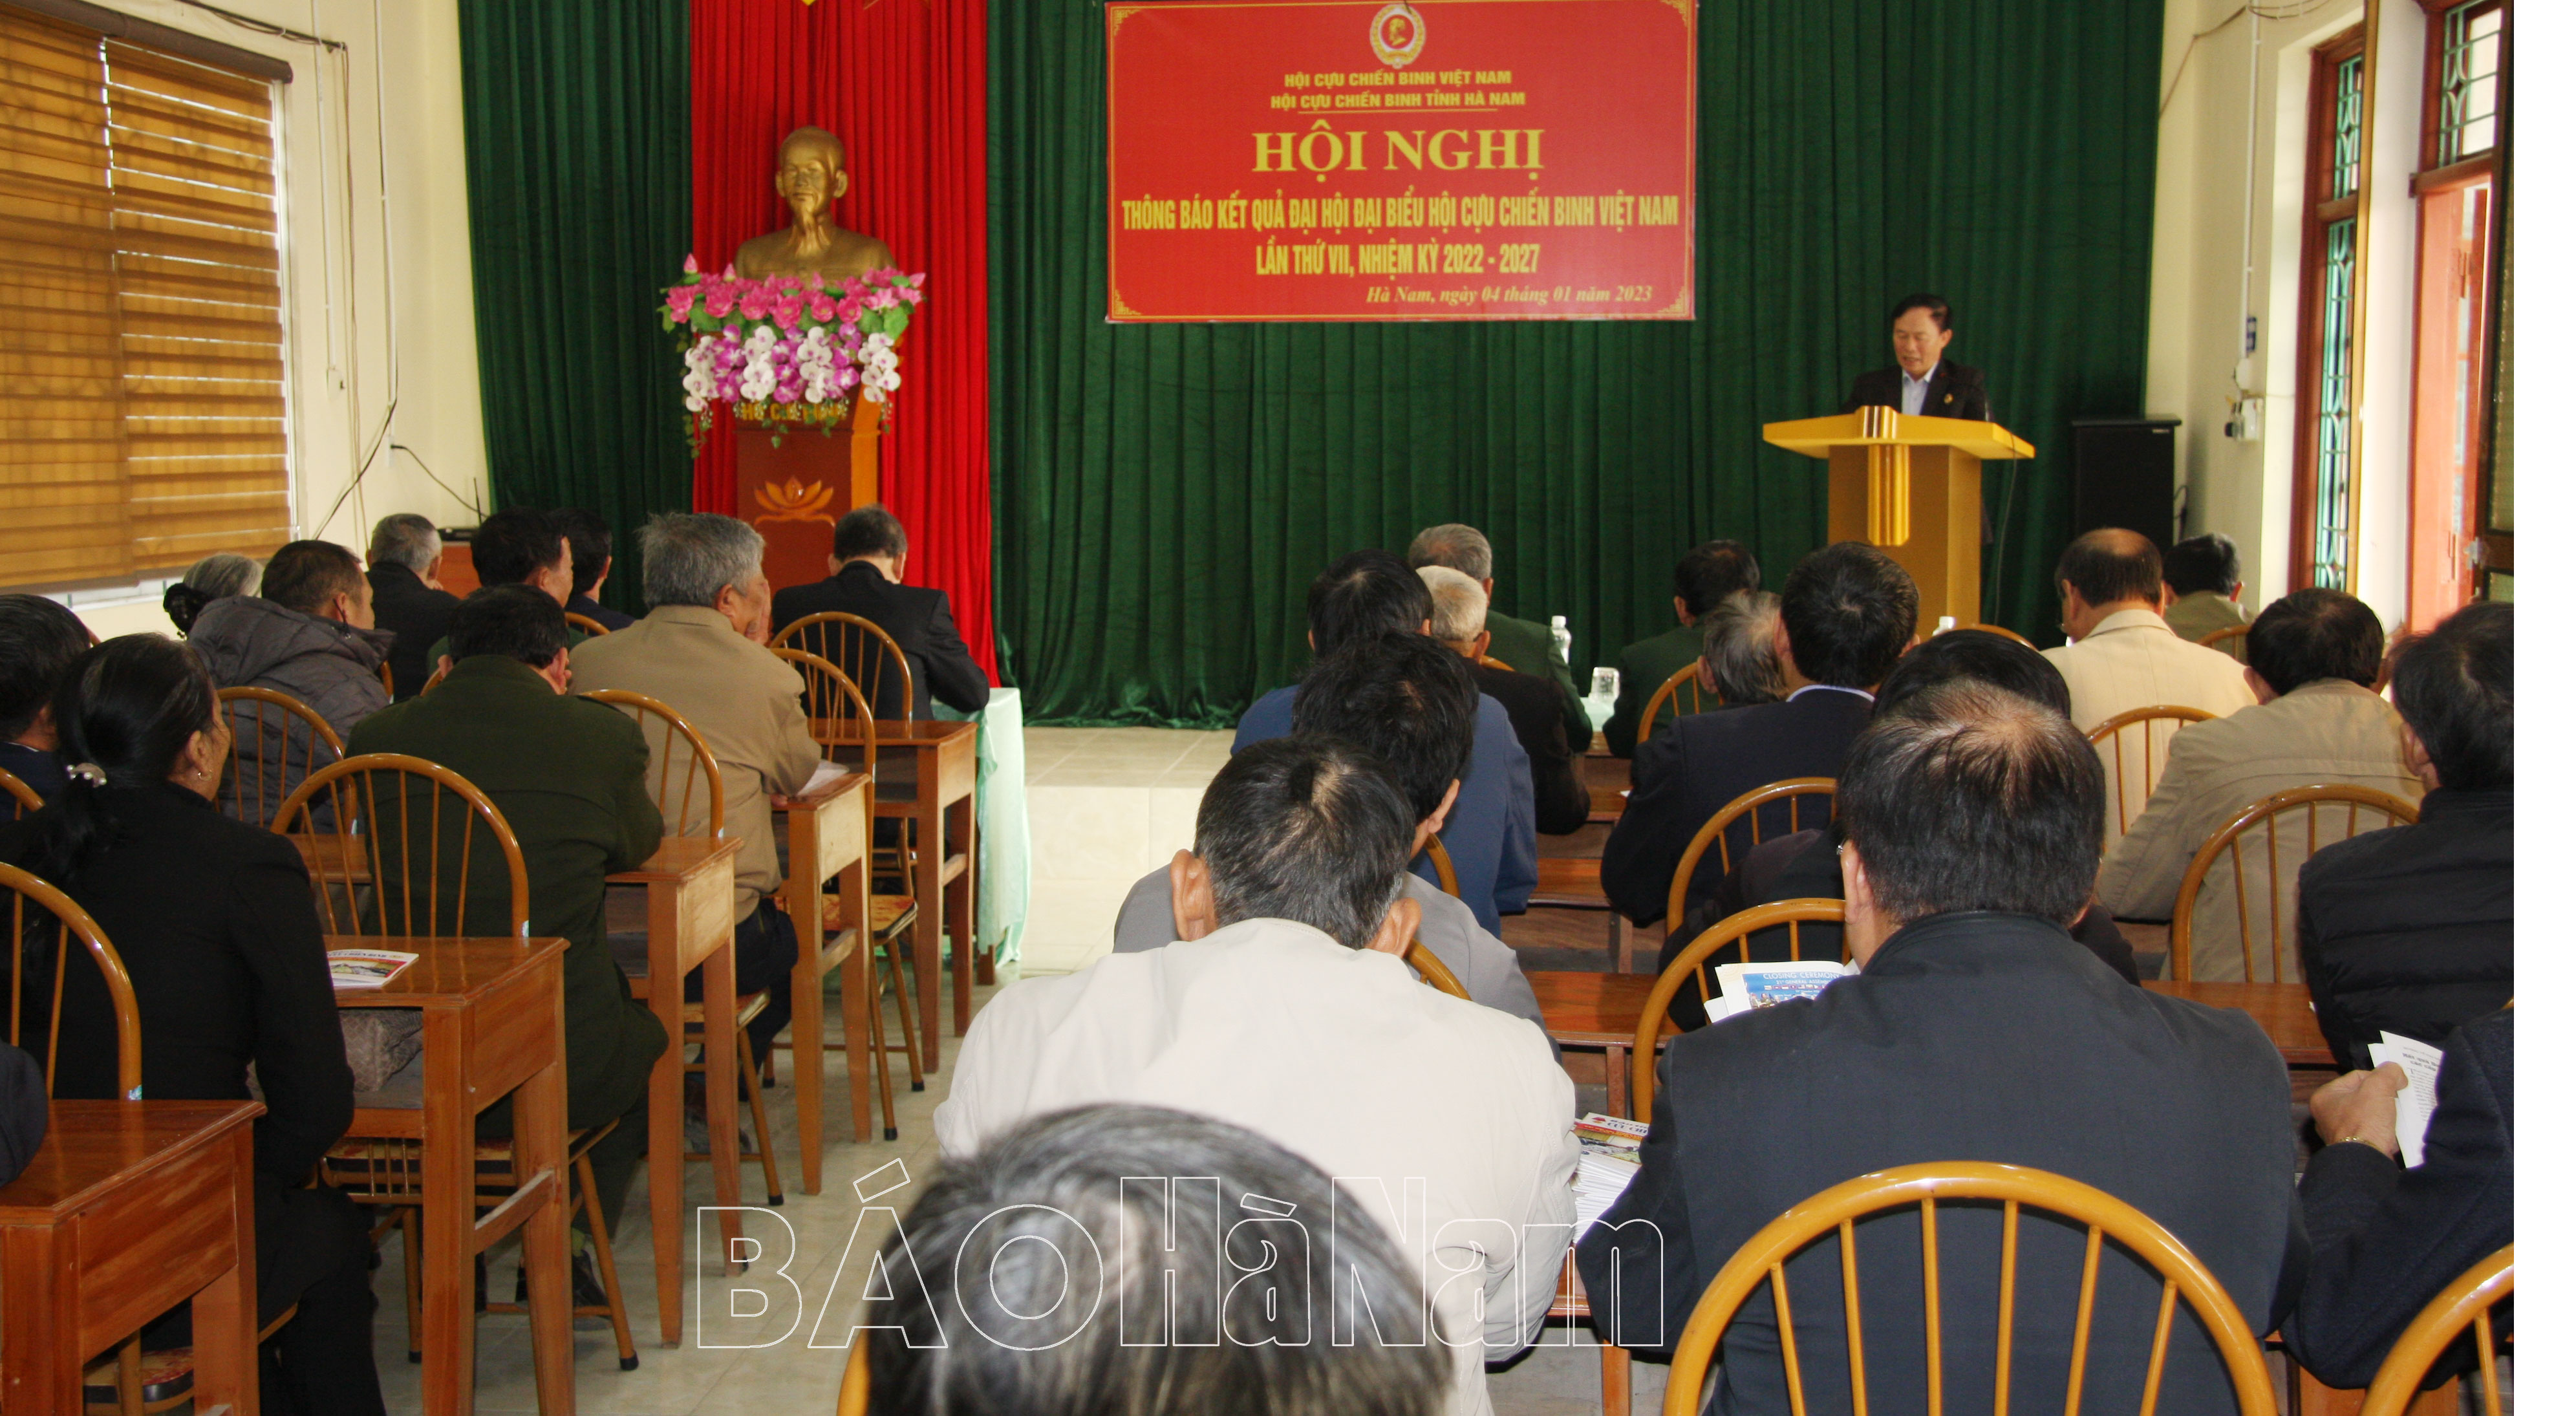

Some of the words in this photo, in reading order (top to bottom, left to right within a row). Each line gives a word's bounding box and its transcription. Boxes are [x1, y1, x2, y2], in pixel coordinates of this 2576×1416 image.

[1284, 71, 1311, 90] HỘI
[1313, 72, 1347, 89] CỰU
[1347, 69, 1396, 87] CHIẾN
[1397, 69, 1437, 85] BINH
[1438, 69, 1472, 87] VIỆT
[1474, 70, 1512, 85] NAM
[1270, 93, 1297, 111] HỘI
[1299, 94, 1333, 111] CỰU
[1335, 91, 1382, 108] CHIẾN
[1382, 93, 1422, 107] BINH
[1425, 89, 1462, 107] TỈNH
[1464, 91, 1487, 106] HÀ
[1487, 91, 1527, 106] NAM
[1252, 119, 1368, 183] HỘI
[1383, 129, 1545, 180] NGHỊ
[1121, 194, 1177, 230] THÔNG
[1177, 193, 1215, 230] BÁO
[1216, 189, 1249, 230] KẾT
[1250, 188, 1287, 232] QUẢ
[1288, 198, 1318, 235] ĐẠI
[1320, 191, 1351, 234] HỘI
[1351, 197, 1383, 235] ĐẠI
[1385, 185, 1425, 228] BIỂU
[1428, 191, 1457, 233] HỘI
[1460, 194, 1496, 233] CỰU
[1498, 187, 1551, 226] CHIẾN
[1553, 196, 1595, 226] BINH
[1598, 190, 1636, 232] VIỆT
[1638, 195, 1679, 226] NAM
[1255, 235, 1291, 275] LẦN
[1291, 238, 1326, 275] THỨ
[1326, 244, 1356, 277] VII,
[1358, 238, 1415, 281] NHIỆM
[1417, 237, 1440, 274] KỲ
[1443, 243, 1485, 274] 2022
[1499, 243, 1541, 273] 2027
[1365, 286, 1391, 303] Hà
[1395, 286, 1436, 303] Nam,
[1439, 286, 1478, 306] ngày
[1481, 286, 1501, 302] 04
[1504, 286, 1549, 306] tháng
[1552, 286, 1572, 301] 01
[1576, 287, 1611, 302] năm
[1616, 285, 1653, 301] 2023
